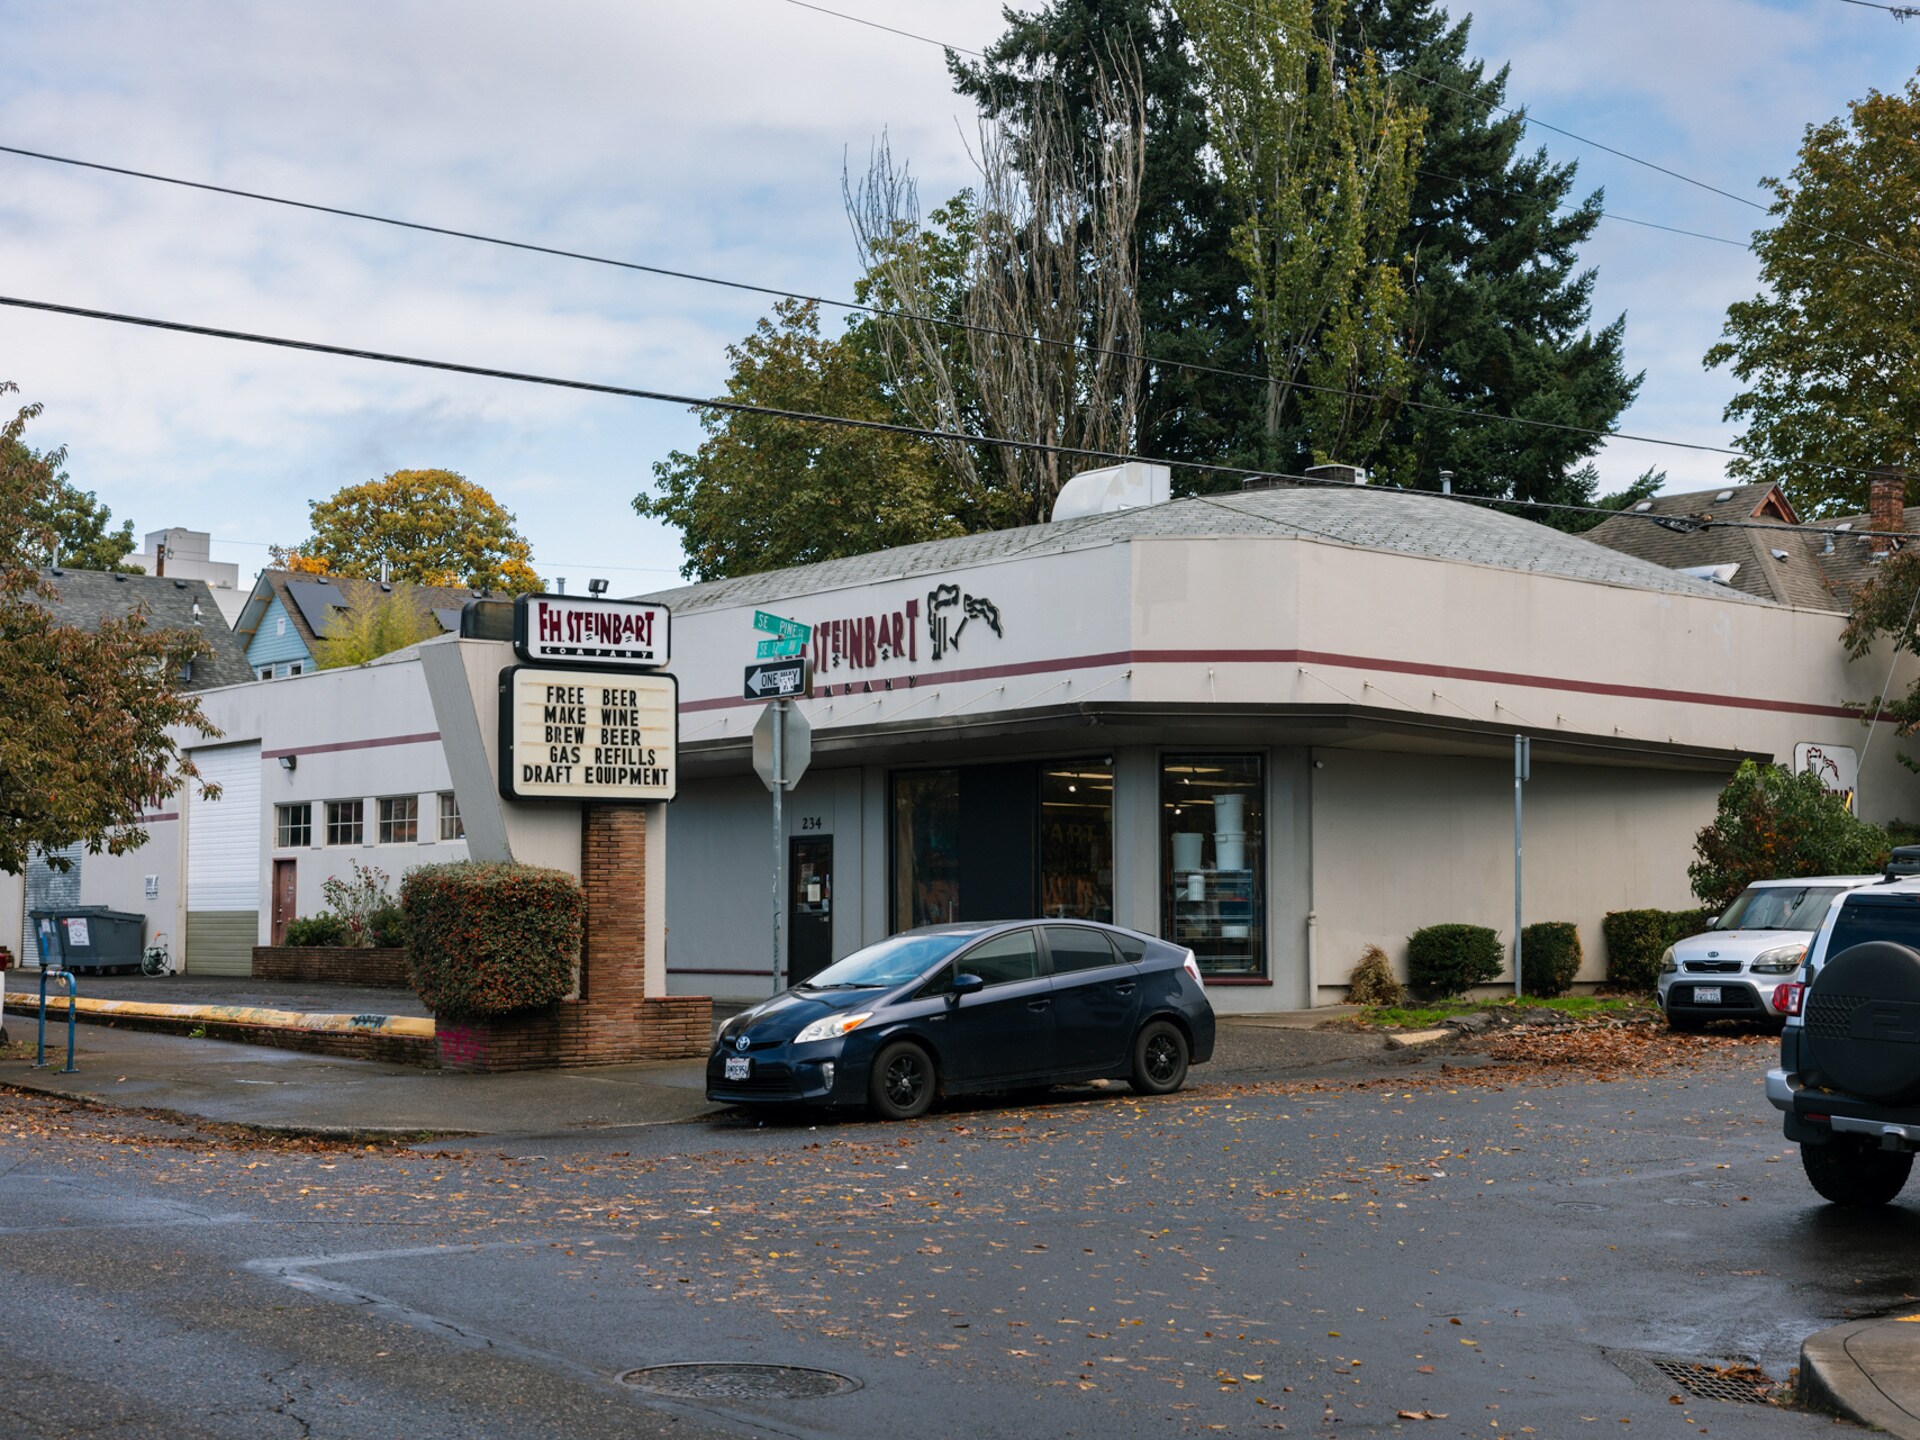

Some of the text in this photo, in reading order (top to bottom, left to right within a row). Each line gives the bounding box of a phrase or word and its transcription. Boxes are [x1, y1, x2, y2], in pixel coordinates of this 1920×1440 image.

[567, 609, 655, 647] STEINBART
[758, 614, 769, 629] SE
[779, 621, 798, 637] PINE
[813, 598, 919, 674] STEINBART
[545, 646, 648, 659] COMPANY
[760, 642, 768, 655] SE
[761, 672, 778, 687] ONE
[807, 675, 917, 698] MPANY
[547, 686, 637, 707] FREE BEER
[544, 706, 639, 727] MAKE WINE
[545, 726, 641, 746] BREW BEER
[550, 746, 655, 766] GAS REFILLS
[523, 765, 668, 785] DRAFT EQUIPMENT
[802, 816, 822, 830] 234
